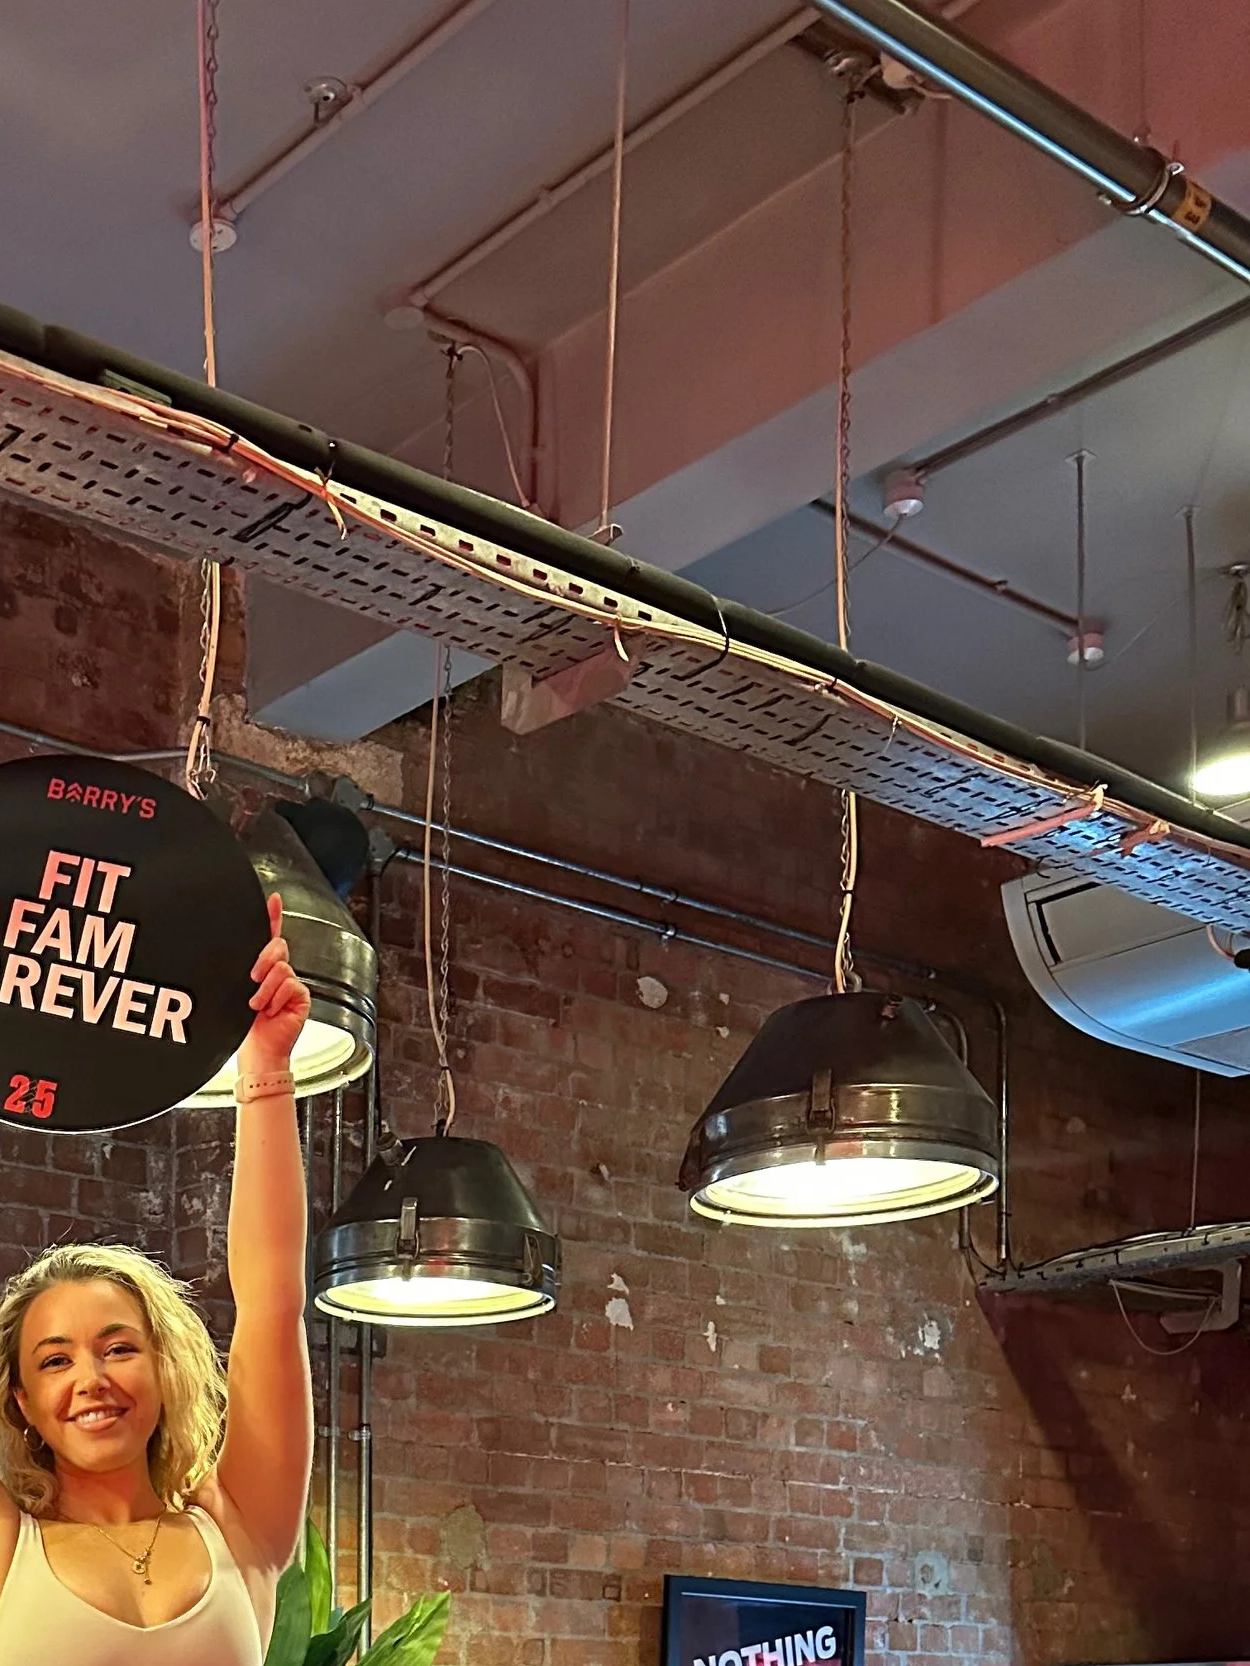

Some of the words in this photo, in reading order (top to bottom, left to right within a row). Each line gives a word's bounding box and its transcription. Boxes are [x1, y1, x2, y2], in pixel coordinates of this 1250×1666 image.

[47, 777, 157, 819] BARRY'S
[38, 850, 132, 914] FIT
[3, 898, 136, 974] FAM
[4, 1074, 58, 1119] 25
